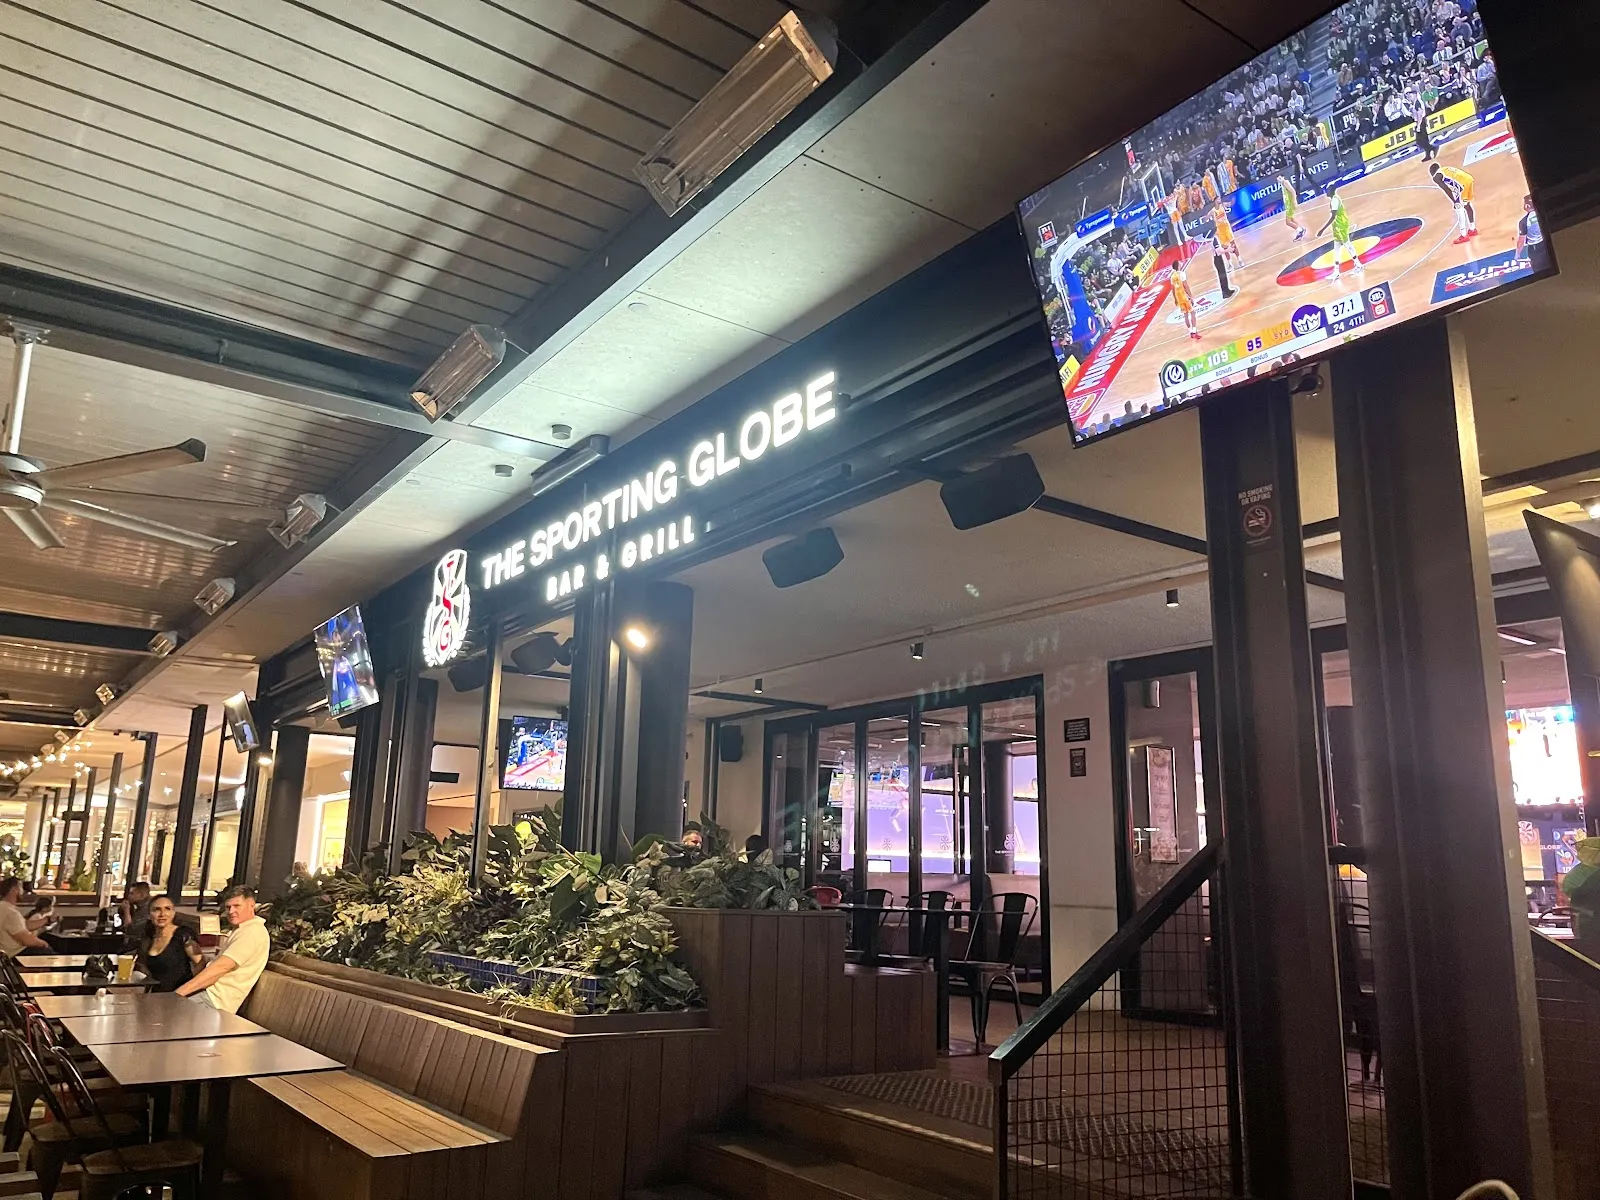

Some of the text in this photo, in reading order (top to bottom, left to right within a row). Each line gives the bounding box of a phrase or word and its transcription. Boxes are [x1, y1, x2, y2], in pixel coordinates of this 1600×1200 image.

[1250, 182, 1285, 202] VIRTUA
[1332, 298, 1354, 317] 37.1
[1333, 314, 1365, 334] 24 4TH
[1246, 329, 1289, 352] 95 SYD
[1207, 349, 1229, 369] 109
[481, 371, 836, 590] THE SPORTING GLOBE
[1247, 484, 1273, 498] SMOKING
[546, 515, 696, 602] BAR & GRILL
